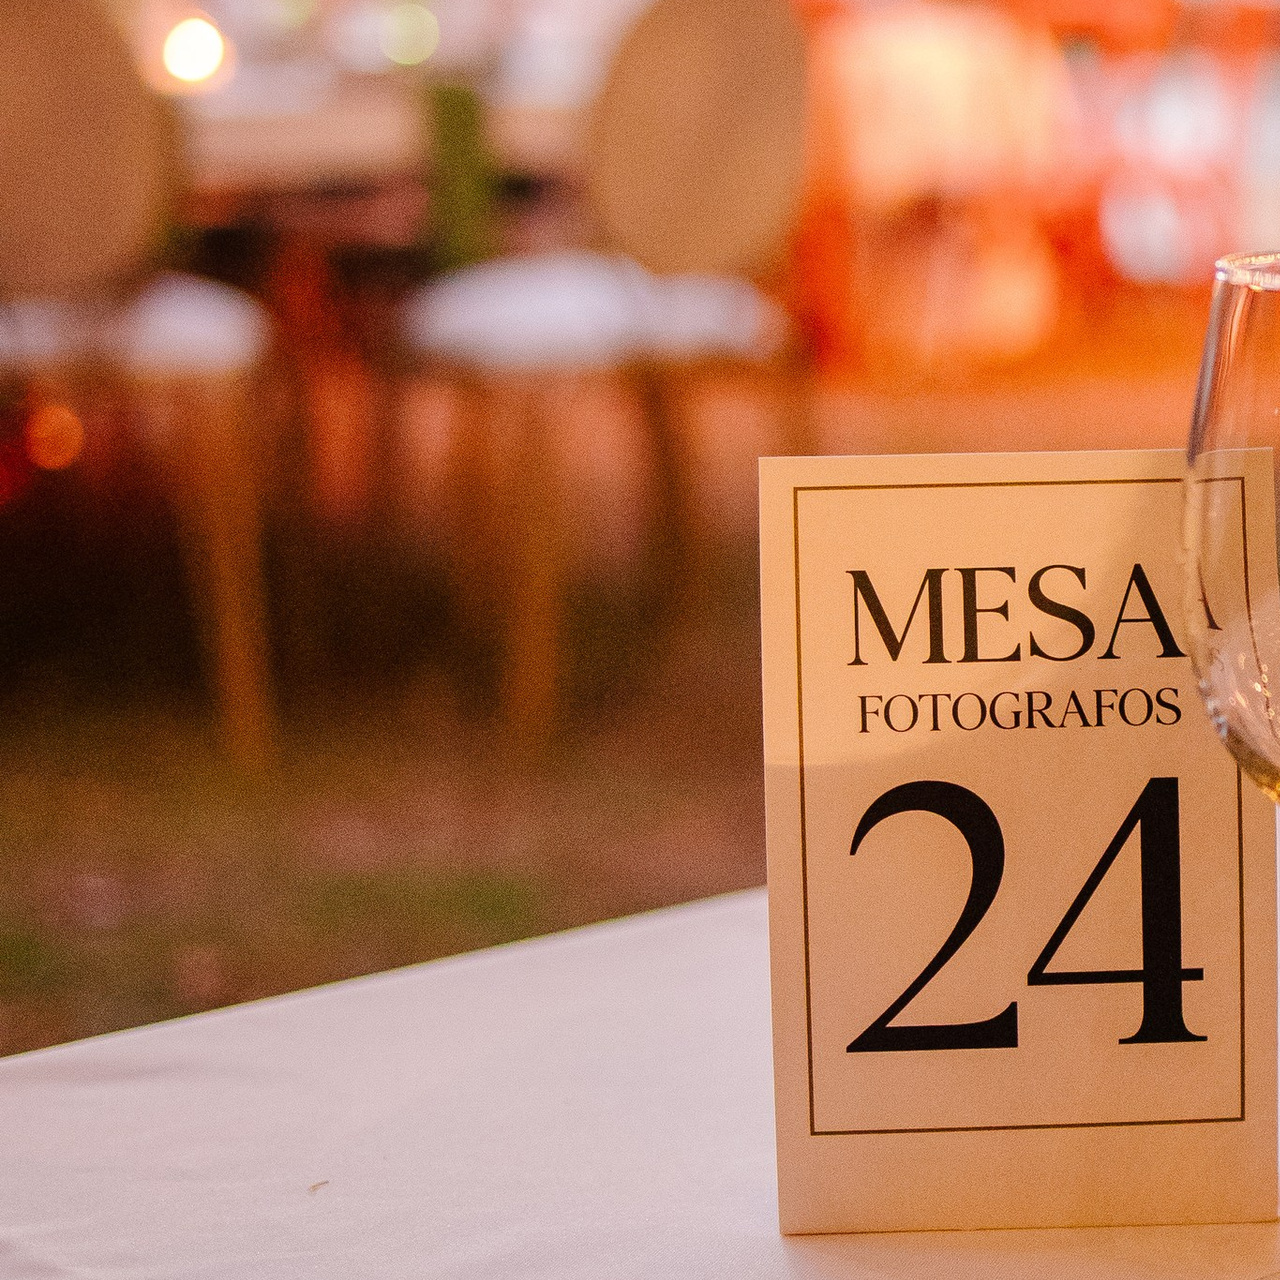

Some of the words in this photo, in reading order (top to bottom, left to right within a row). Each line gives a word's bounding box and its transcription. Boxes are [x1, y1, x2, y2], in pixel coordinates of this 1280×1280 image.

[845, 563, 1188, 666] MESA
[858, 687, 1182, 733] FOTOGRAFOS
[845, 776, 1208, 1053] 24
